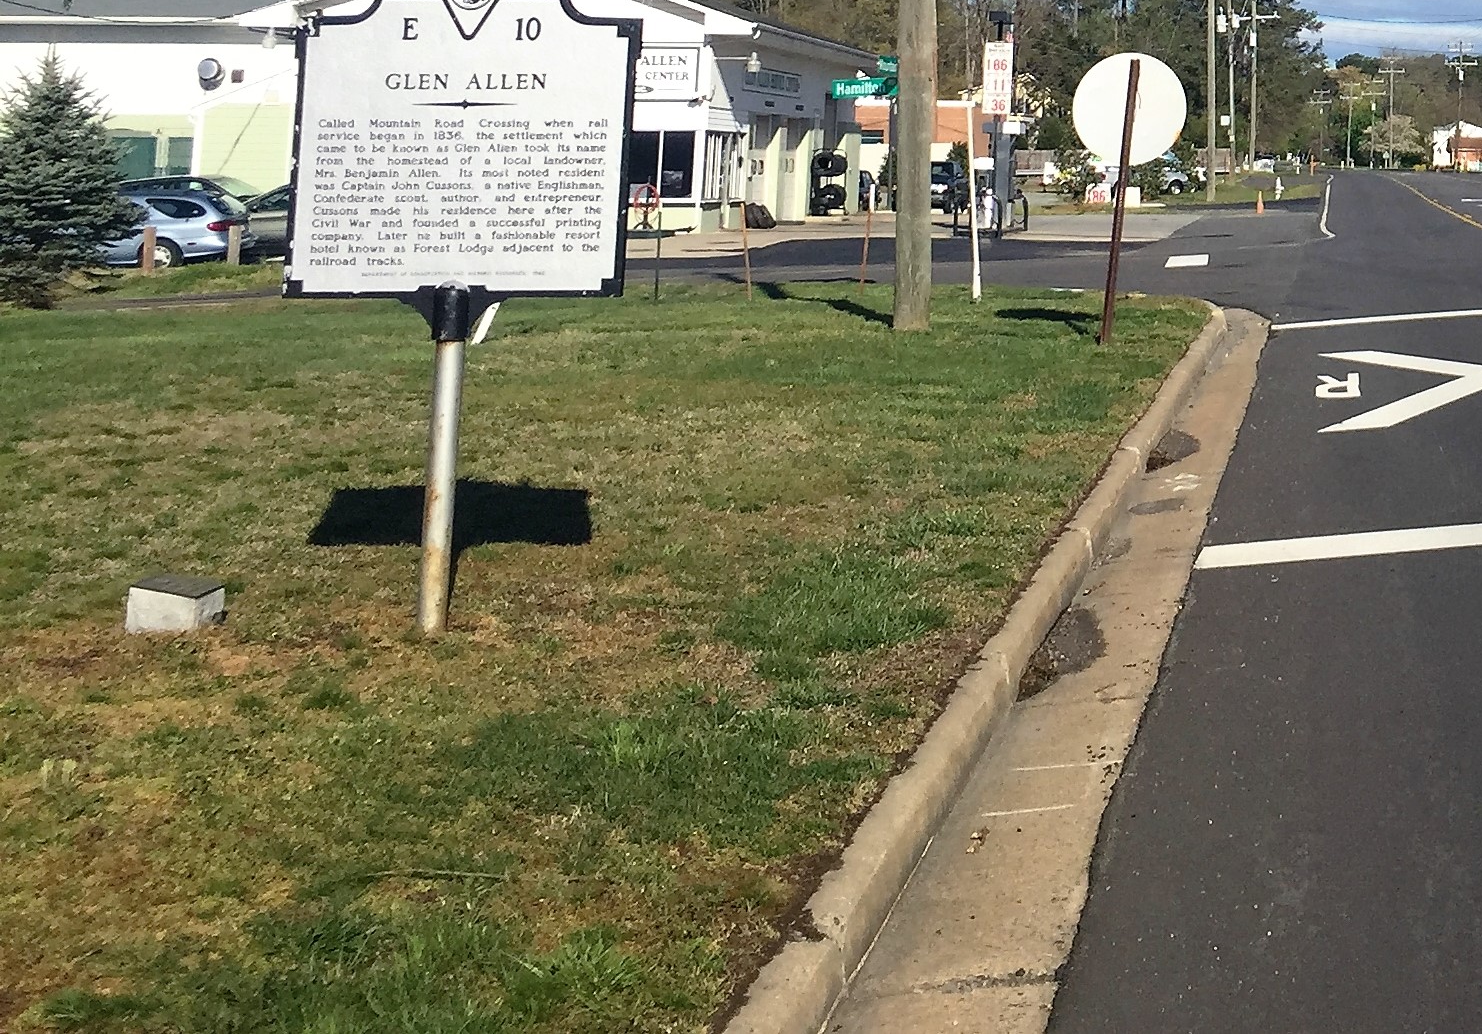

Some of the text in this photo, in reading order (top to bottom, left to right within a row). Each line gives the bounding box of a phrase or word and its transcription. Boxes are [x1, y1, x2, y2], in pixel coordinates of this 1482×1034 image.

[402, 17, 541, 41] E 10
[640, 55, 688, 66] ALLEN
[385, 72, 548, 90] GLEN ALLEN
[645, 71, 689, 81] CENTER
[836, 81, 886, 96] Hamilton
[319, 118, 608, 130] Called Mountain Road Crossing when rail
[318, 131, 359, 141] service
[370, 131, 405, 143] began
[414, 131, 424, 141] in
[476, 131, 494, 141] the
[503, 131, 563, 141] settlement
[573, 131, 607, 141] which
[354, 144, 365, 153] to
[372, 144, 385, 153] be
[393, 144, 429, 153] known
[455, 144, 480, 153] Glen
[487, 144, 517, 153] Allen
[525, 144, 549, 153] took
[558, 144, 570, 153] its
[316, 156, 343, 166] from
[356, 156, 375, 166] the
[387, 156, 448, 166] homestead
[460, 156, 472, 166] of
[484, 158, 491, 166] a
[504, 156, 531, 166] local
[344, 168, 399, 180] Benjamin
[459, 168, 472, 178] Its
[482, 168, 509, 178] most
[518, 168, 549, 178] noted
[559, 168, 605, 178] resident
[342, 181, 385, 193] Captain
[392, 181, 419, 191] John
[497, 181, 531, 191] native
[314, 194, 384, 203] Confederate
[495, 194, 515, 203] and
[313, 206, 603, 216] Cussons made his residence here after the
[312, 218, 338, 228] Civil
[349, 218, 371, 228] War
[382, 218, 402, 228] and
[413, 218, 458, 228] founded
[486, 218, 545, 228] successful
[556, 218, 601, 230] printing
[378, 231, 407, 241] Later
[440, 231, 465, 241] built
[492, 231, 556, 241] fashionable
[565, 231, 600, 241] resort
[310, 244, 339, 253] hotel
[348, 244, 385, 253] known
[414, 244, 450, 253] Forest
[502, 244, 554, 256] adjacent
[562, 244, 574, 253] to
[582, 244, 600, 253] the
[310, 256, 404, 266] railroad tracks.
[1314, 371, 1362, 399] R
